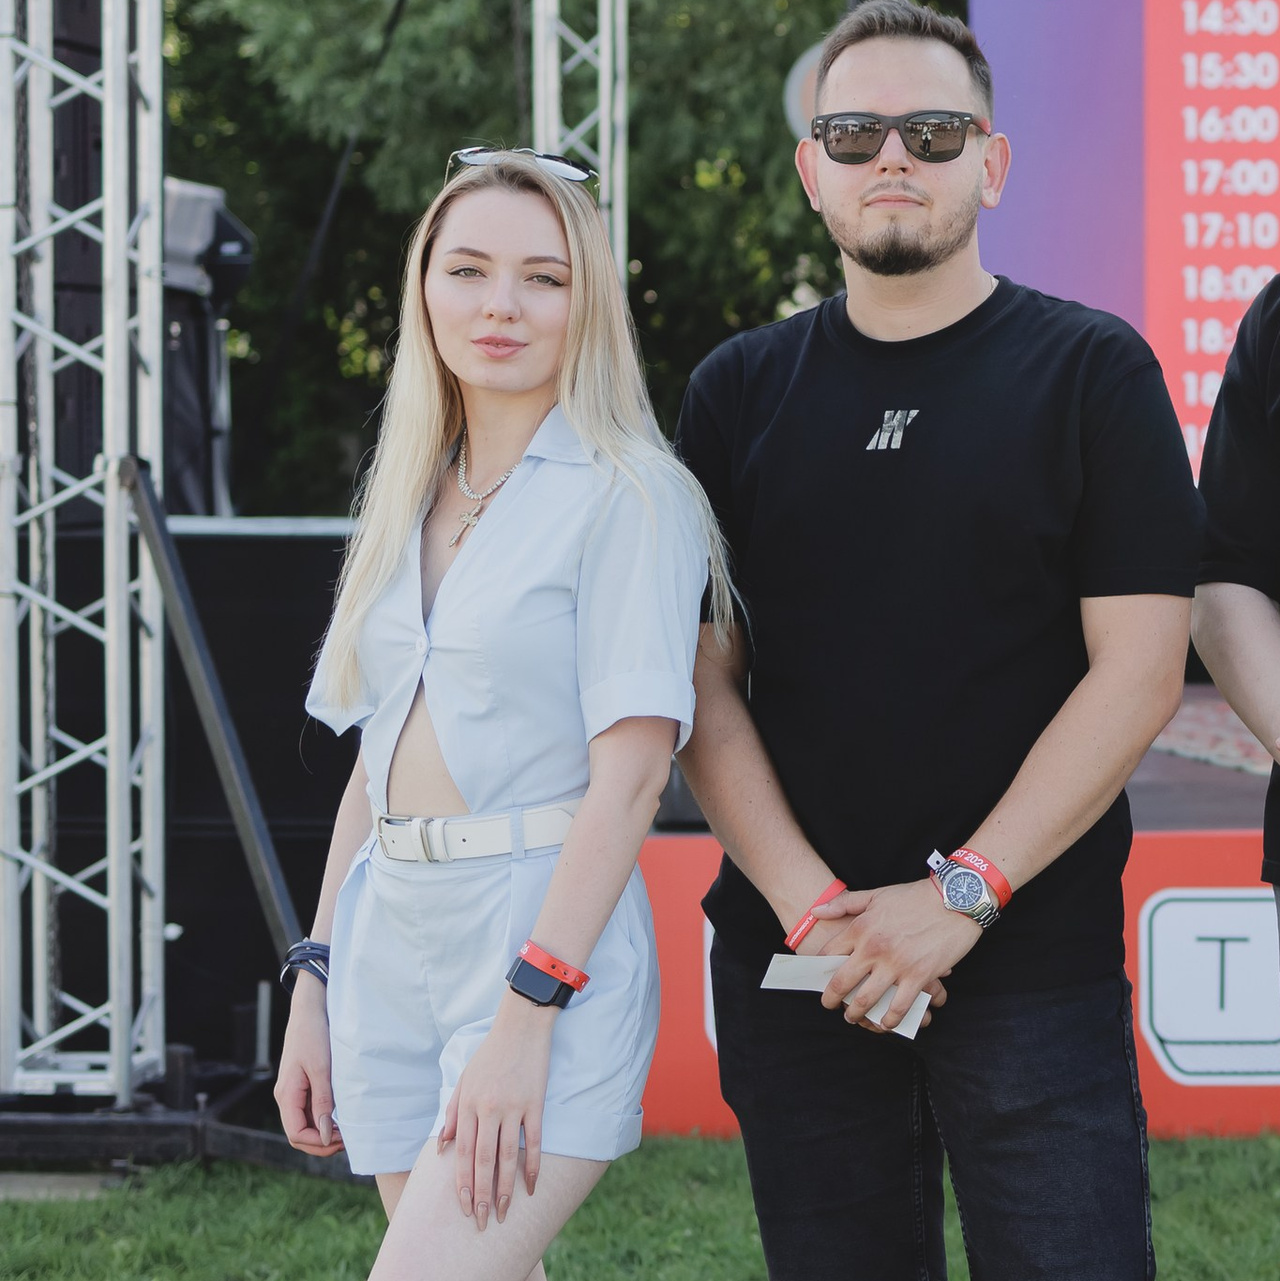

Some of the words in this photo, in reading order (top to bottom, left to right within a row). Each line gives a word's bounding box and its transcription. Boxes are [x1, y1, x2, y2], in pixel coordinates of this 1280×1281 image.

[1182, 52, 1280, 89] 15:30
[1182, 105, 1280, 143] 16:00
[1182, 159, 1280, 196] 17:00
[1182, 212, 1280, 249] 17:10
[964, 852, 989, 872] 2026
